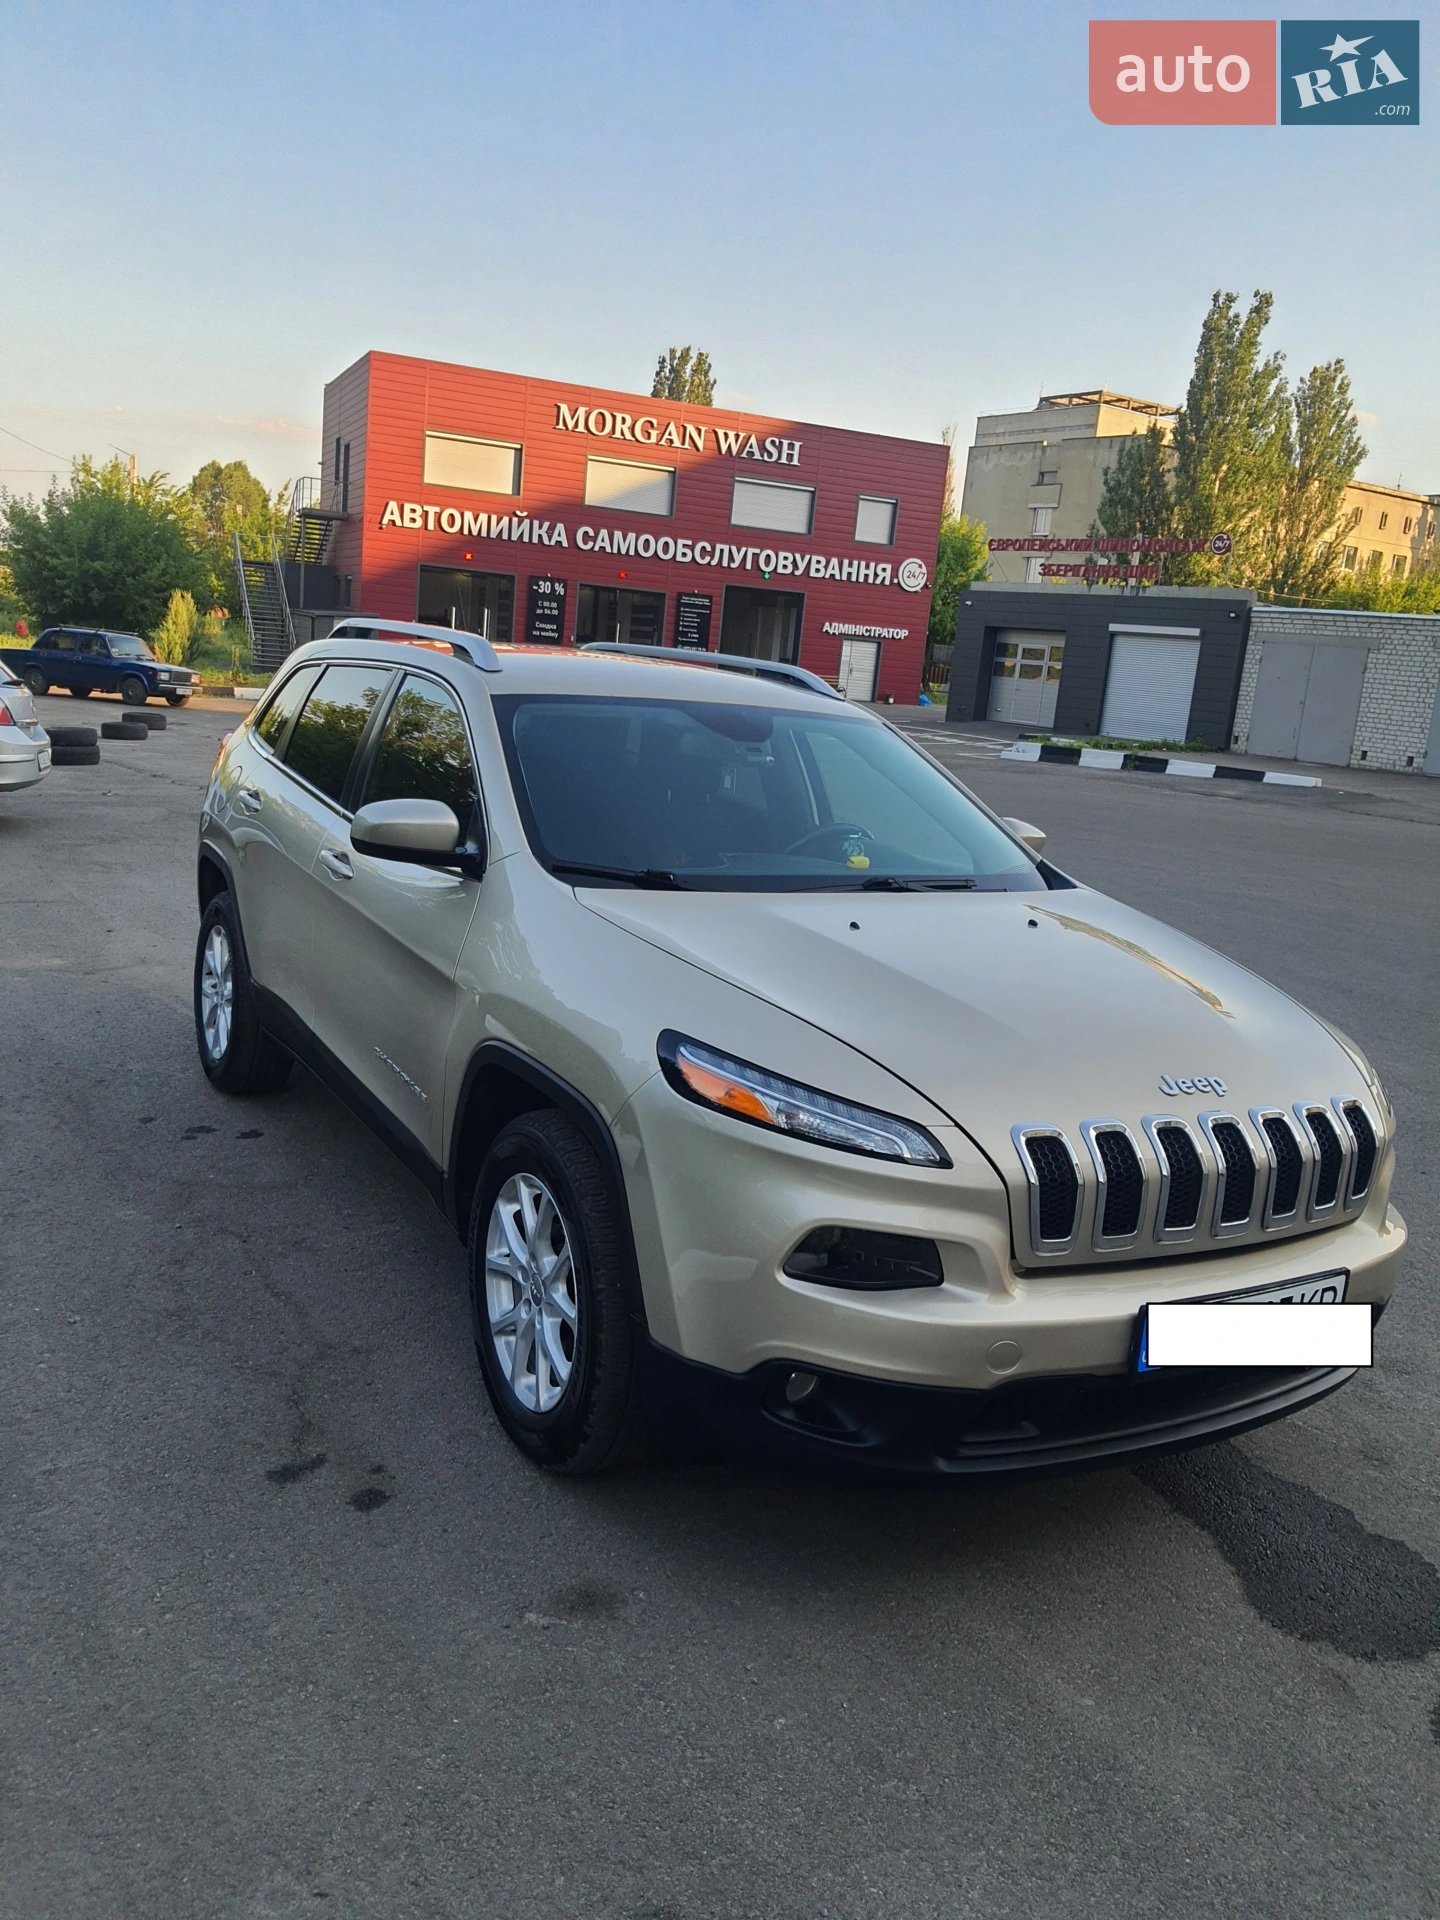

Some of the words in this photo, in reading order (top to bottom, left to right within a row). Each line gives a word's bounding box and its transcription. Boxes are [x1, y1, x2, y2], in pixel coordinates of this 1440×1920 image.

[555, 402, 708, 451] MORGAN
[714, 428, 803, 466] WASH
[381, 500, 568, 547] АВТОМИЙКА
[576, 526, 892, 585] САМООБСЛУГОВУВАННЯ
[1214, 540, 1230, 548] 24/7
[906, 570, 926, 580] 24/7
[533, 581, 551, 593] -30
[822, 622, 909, 640] АДМІНІСТРАТОР
[1158, 1074, 1228, 1097] Jeep
